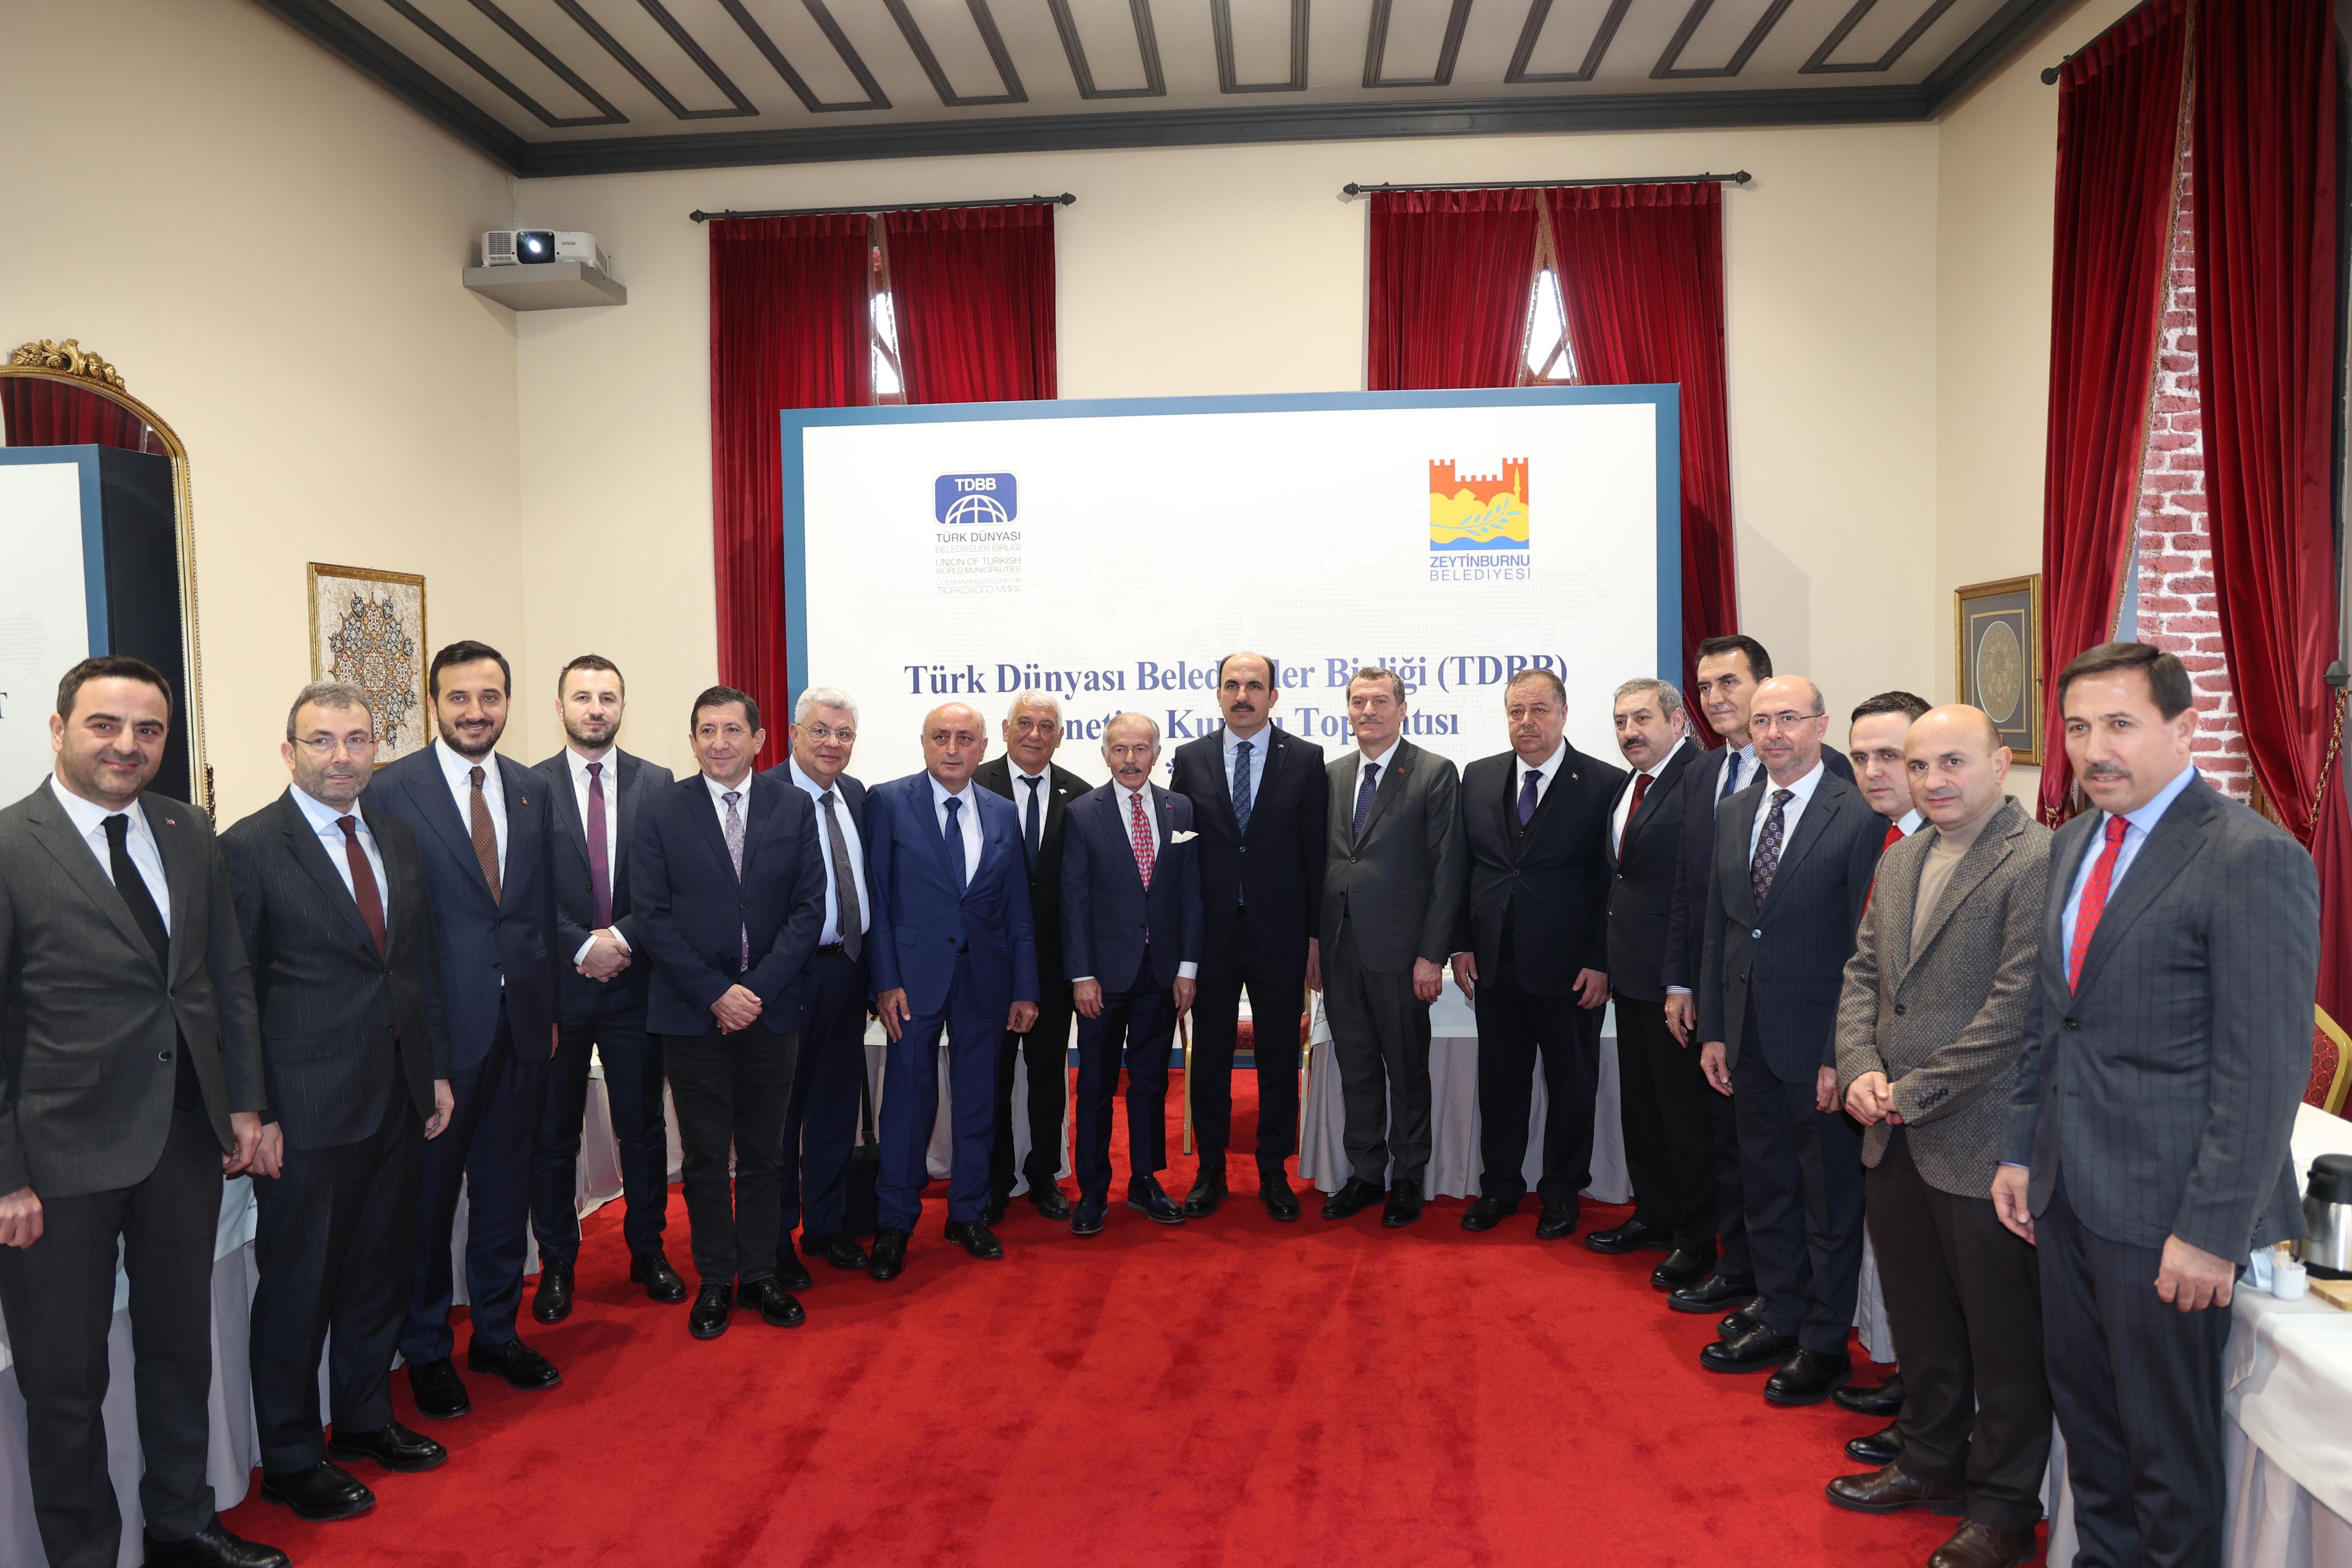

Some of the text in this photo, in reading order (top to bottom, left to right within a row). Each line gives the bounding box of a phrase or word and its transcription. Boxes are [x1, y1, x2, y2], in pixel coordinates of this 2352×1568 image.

[955, 477, 997, 492] TDBB
[936, 530, 1020, 542] TÜRK DÜNYASI
[935, 543, 1021, 553] BELEDİYELER BİRLİĞİ
[982, 557, 1021, 565] TURKISH
[1430, 554, 1530, 568] ZEYTİNBURNU
[1430, 566, 1530, 581] BELEDİYESİ
[937, 585, 1021, 594] ТЮРКСКОГО МИРА
[904, 665, 987, 694] Türk
[995, 663, 1126, 700] Dünyası
[1135, 659, 1315, 690] Beledler
